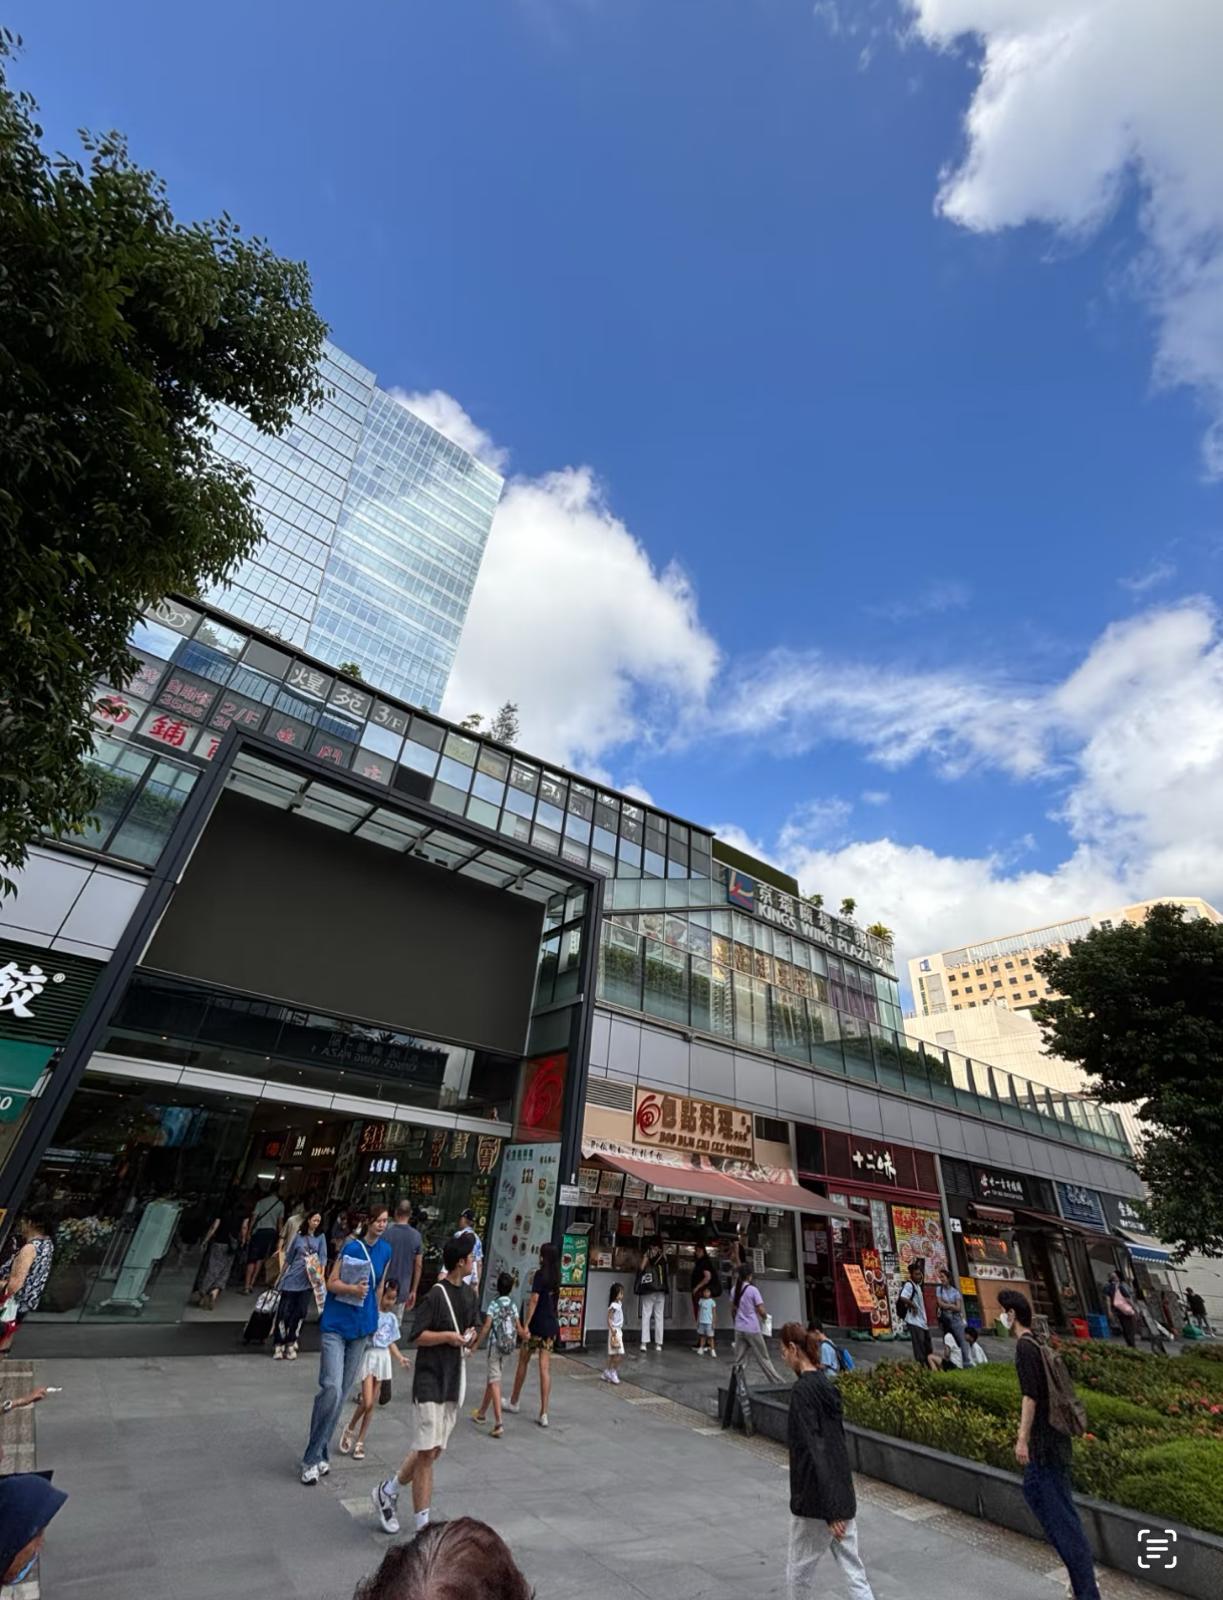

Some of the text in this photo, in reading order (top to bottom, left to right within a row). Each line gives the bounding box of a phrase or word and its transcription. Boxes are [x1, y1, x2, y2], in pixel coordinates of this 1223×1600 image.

[221, 701, 260, 725] 2/F
[290, 667, 403, 729] 煌苑 3/F
[758, 905, 798, 931] KINGS
[801, 920, 834, 948] WING
[836, 938, 873, 964] PLAZA
